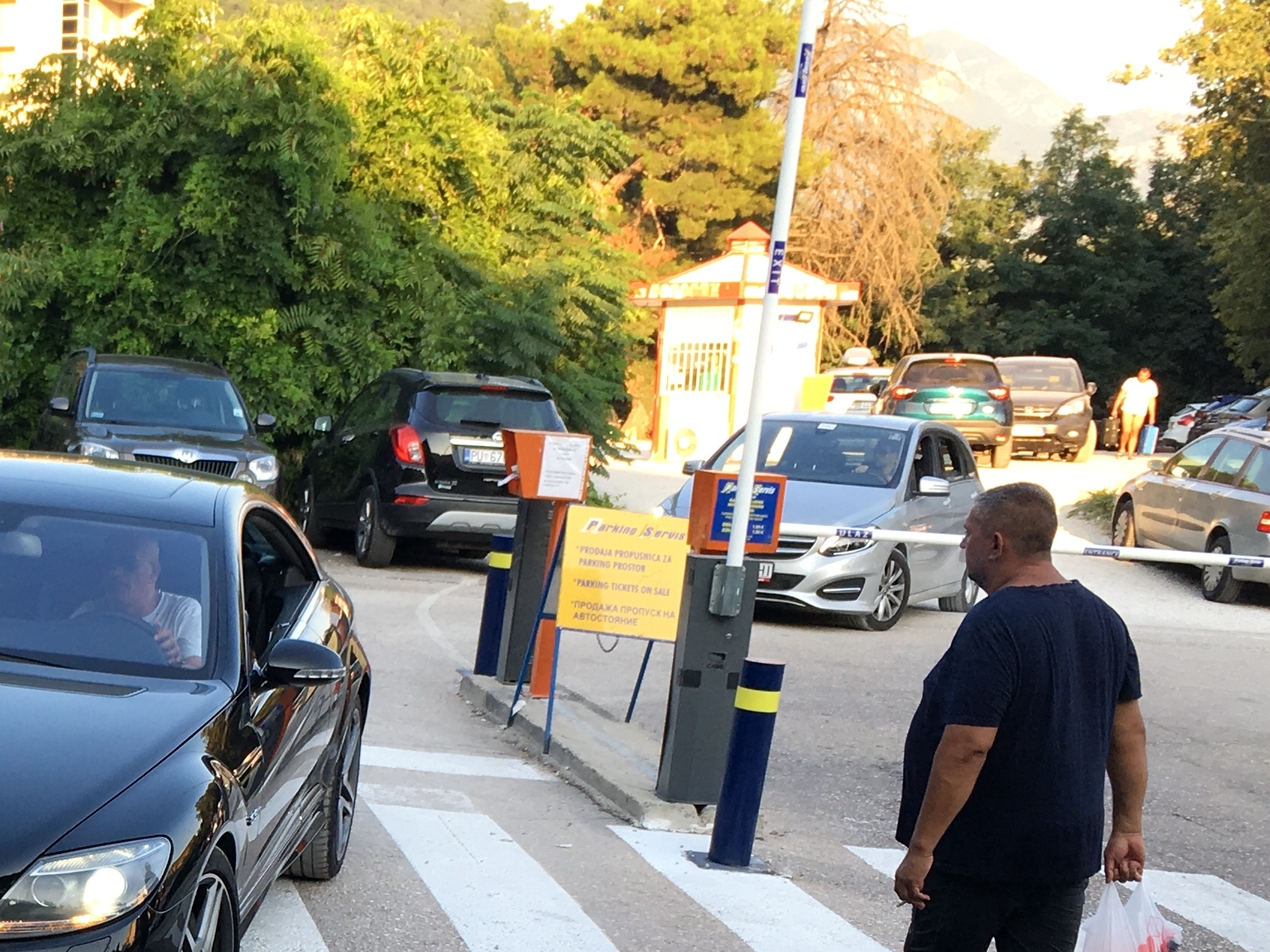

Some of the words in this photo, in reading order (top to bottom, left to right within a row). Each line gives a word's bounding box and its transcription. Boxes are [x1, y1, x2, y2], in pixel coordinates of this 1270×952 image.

[770, 249, 783, 285] EXIT
[582, 519, 638, 536] Parking
[640, 525, 686, 540] Servis
[839, 529, 869, 538] ULAZ
[614, 549, 661, 562] PROPUSNICA
[662, 554, 672, 563] ZA
[579, 557, 611, 569] PARKING
[613, 561, 646, 572] PROSTOR
[611, 582, 639, 593] TICKETS
[641, 587, 652, 595] ON
[654, 588, 671, 597] SALE
[572, 611, 638, 626] АВТОСТОЯНИЕ
[620, 605, 661, 618] ПРОПУСК
[663, 610, 676, 619] НА
